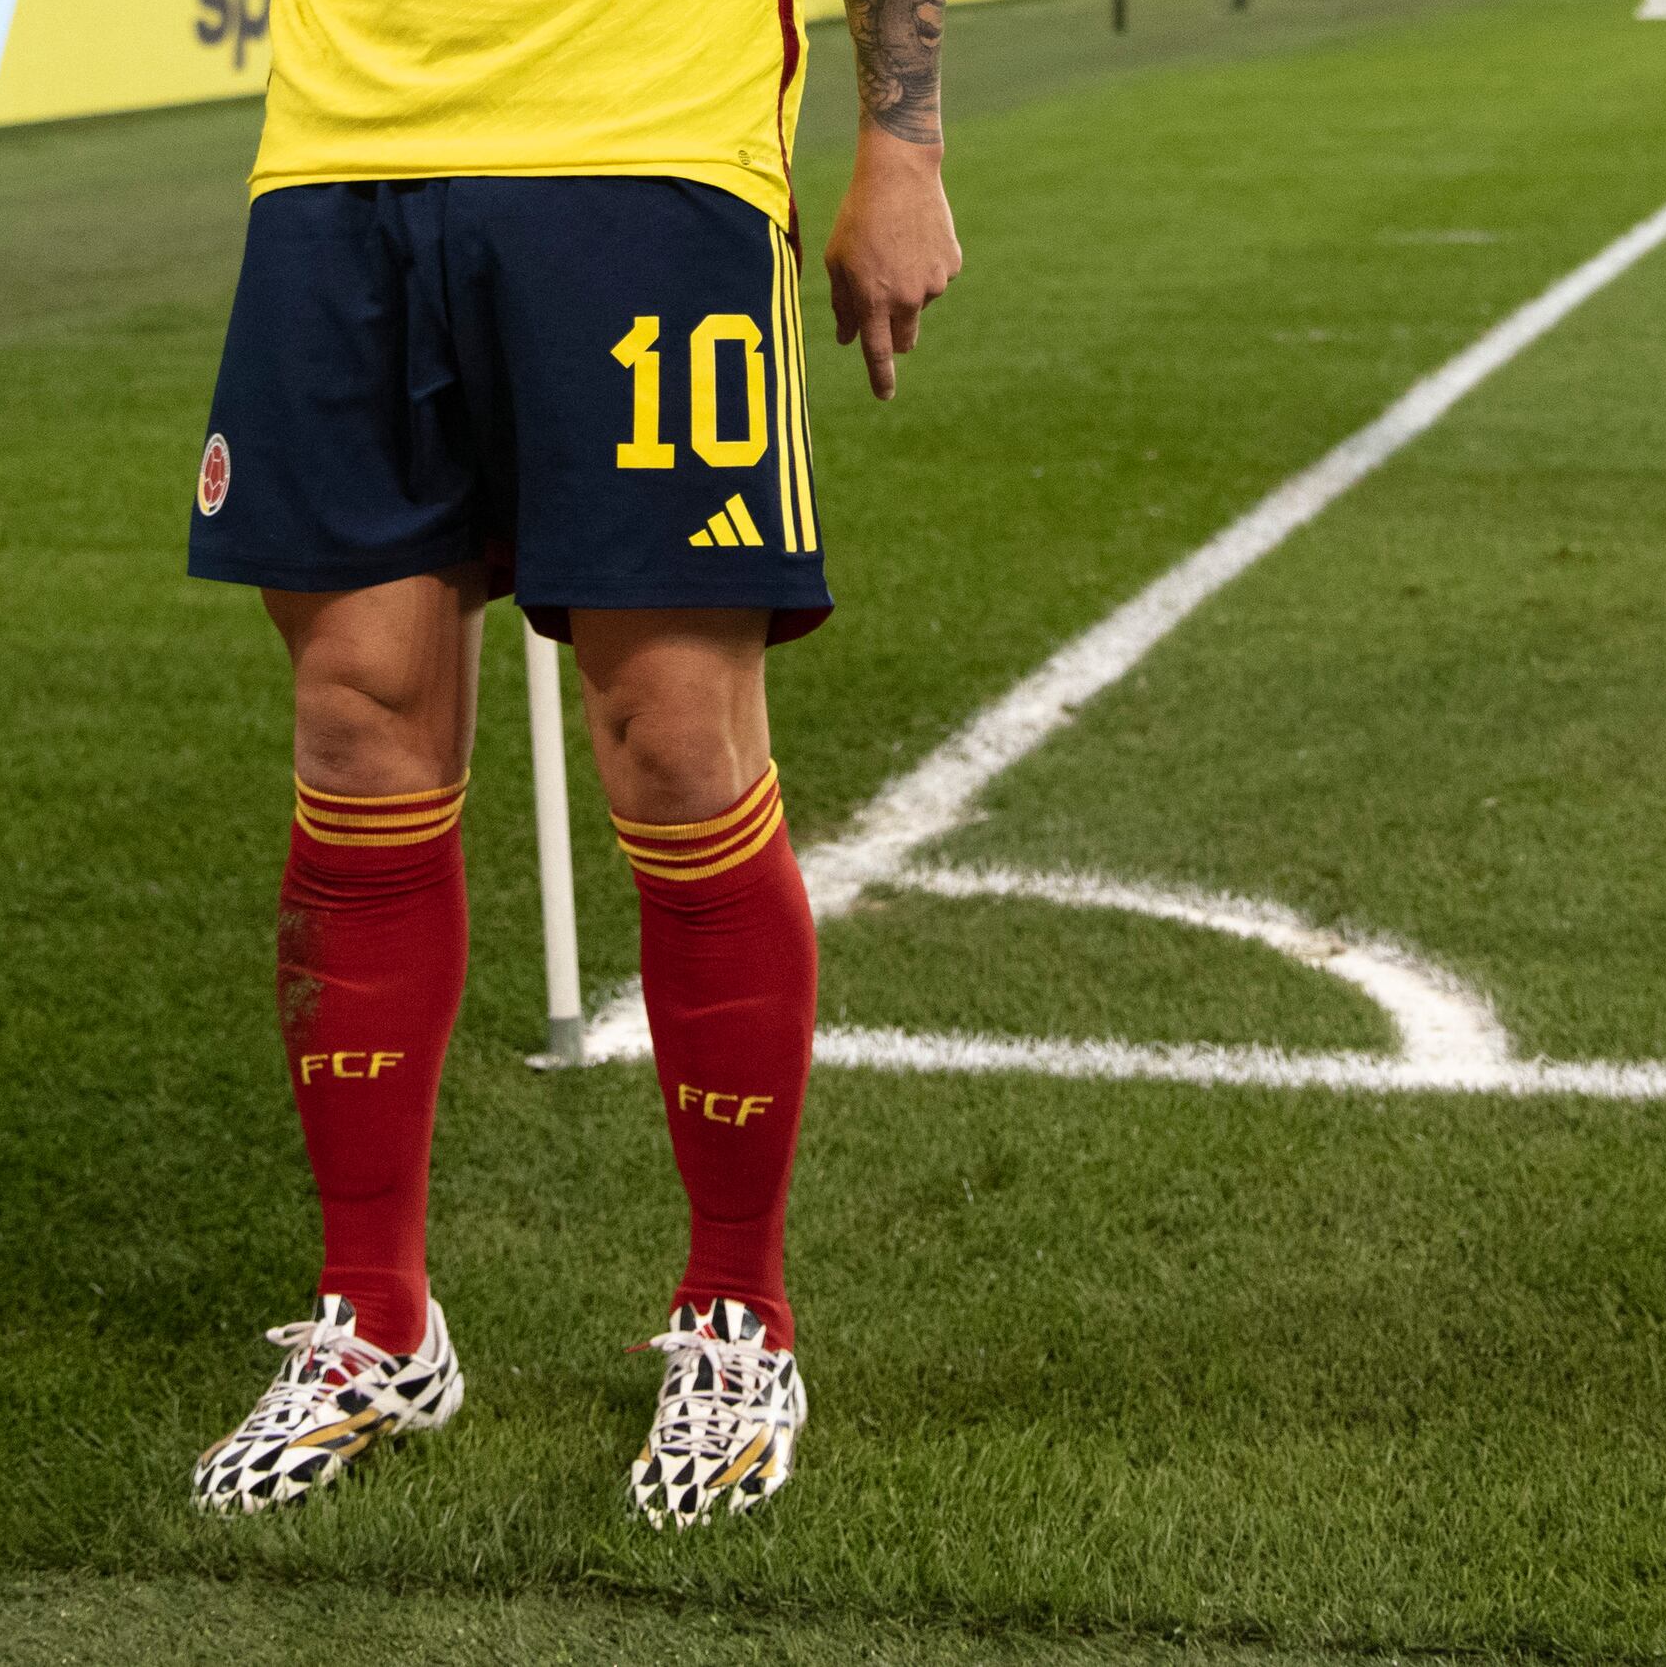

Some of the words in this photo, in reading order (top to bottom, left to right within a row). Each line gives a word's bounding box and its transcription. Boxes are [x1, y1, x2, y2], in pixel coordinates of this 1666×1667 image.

[610, 313, 769, 469] 10
[300, 1050, 405, 1085] FCF
[677, 1083, 774, 1127] FCF
